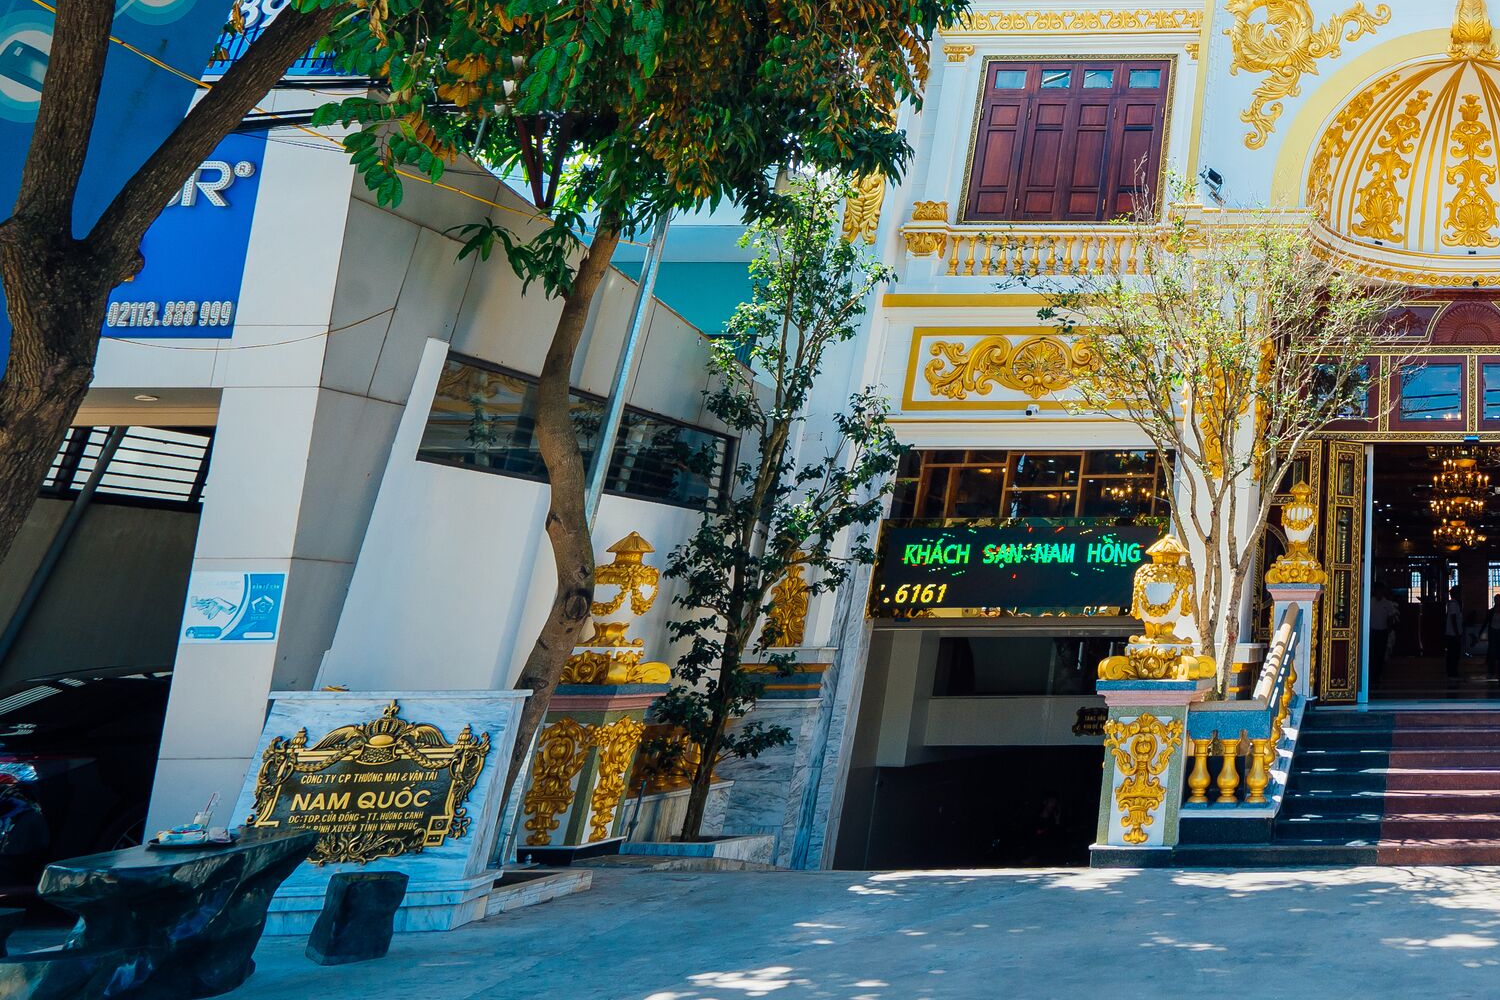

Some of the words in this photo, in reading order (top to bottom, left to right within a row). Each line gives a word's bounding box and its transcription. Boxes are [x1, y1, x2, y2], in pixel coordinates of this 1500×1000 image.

[904, 538, 970, 564] KHÁCH
[982, 543, 1023, 568] SẠN
[1033, 543, 1075, 563] NAM
[1087, 535, 1141, 563] HỒNG
[301, 773, 323, 784] CÔNG
[325, 775, 337, 783] TY
[338, 774, 351, 783] CP
[354, 772, 383, 782] THƯƠNG
[385, 773, 400, 784] MẠI
[290, 793, 351, 811] NAM
[357, 783, 432, 809] QUỐC
[405, 811, 424, 819] CANH
[331, 822, 356, 832] XUYÊN
[398, 820, 419, 830] PHÚC
